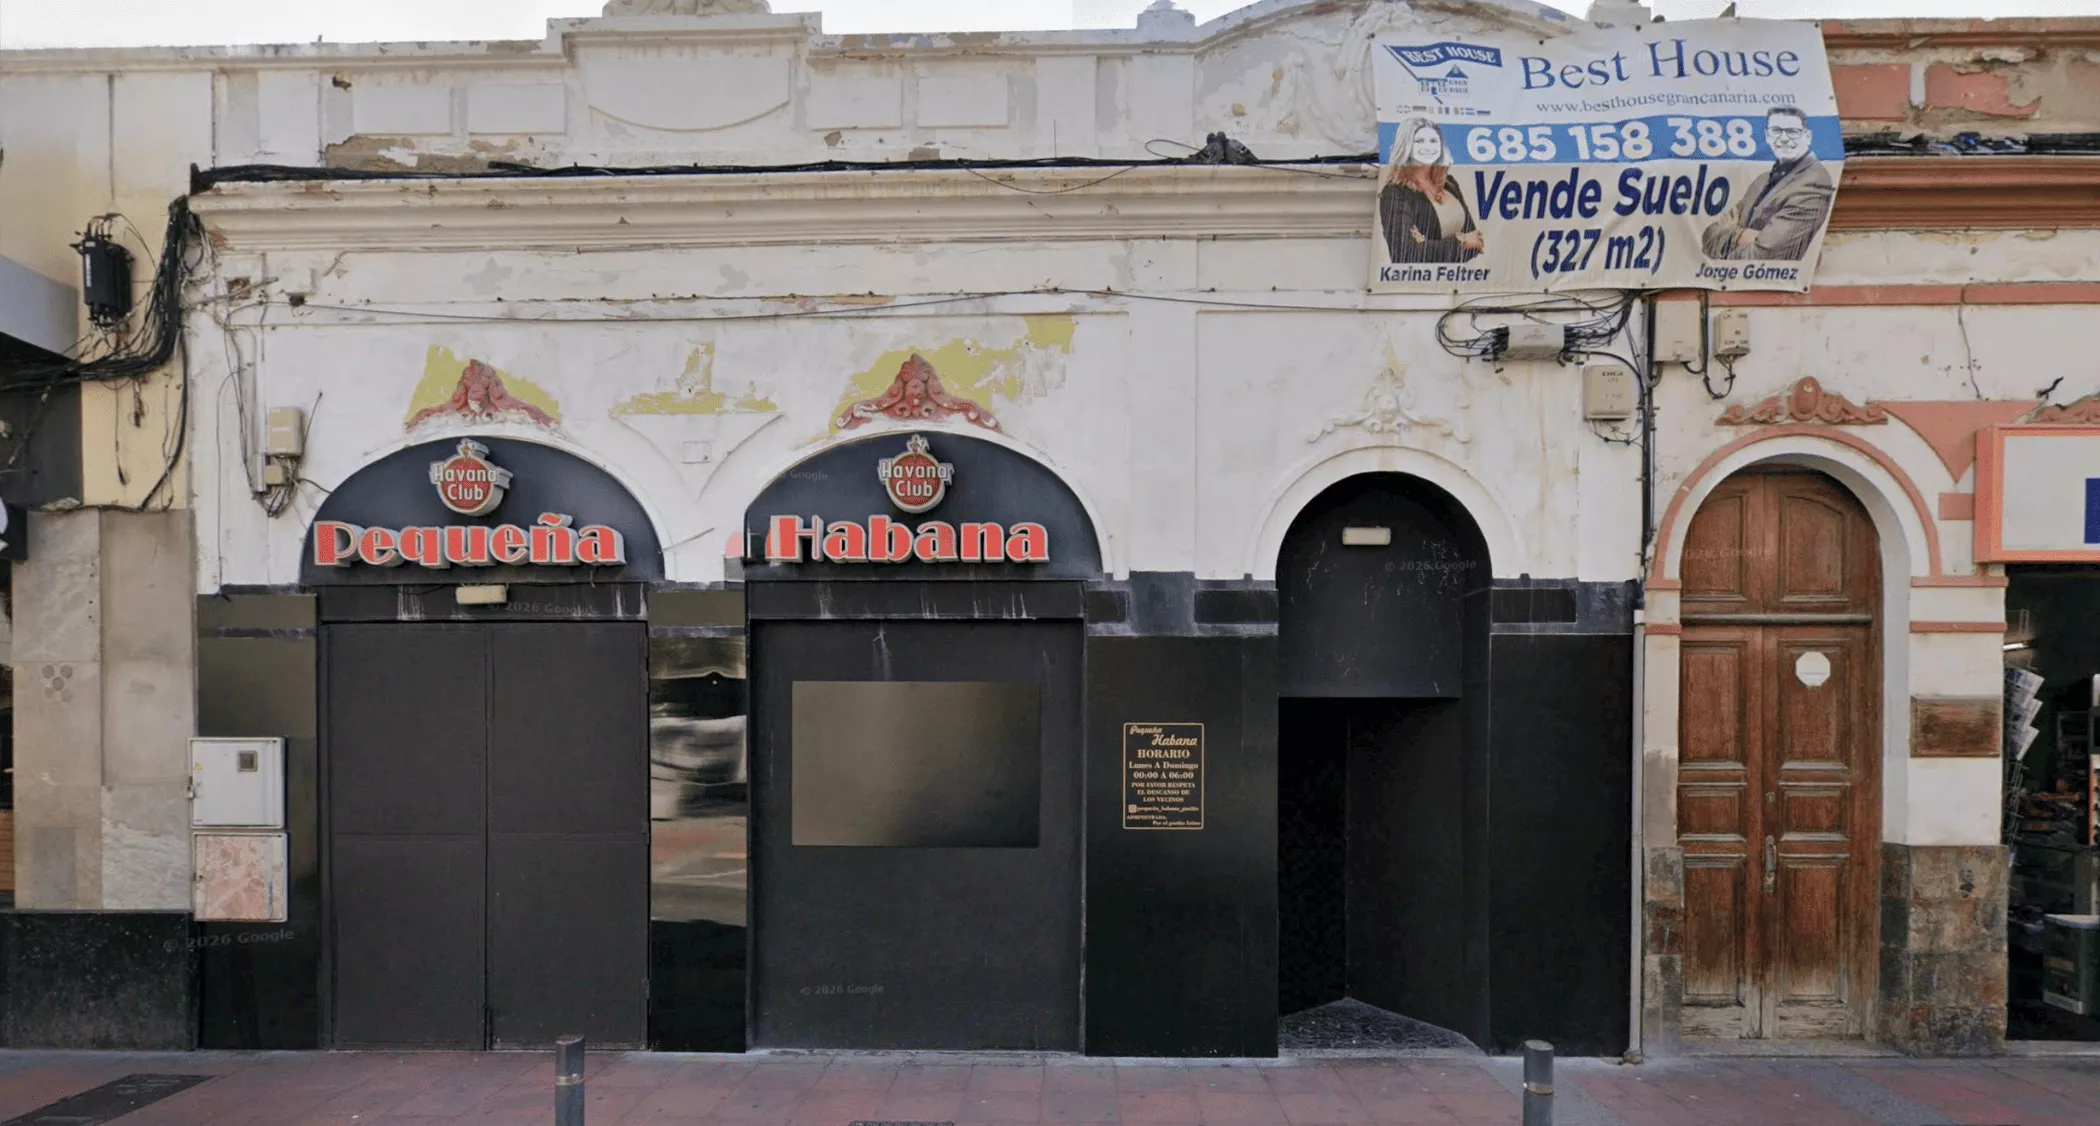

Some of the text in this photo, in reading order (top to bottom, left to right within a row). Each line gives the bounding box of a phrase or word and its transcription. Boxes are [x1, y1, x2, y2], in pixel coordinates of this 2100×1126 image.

[1401, 46, 1497, 63] BEST HOUSE
[1520, 38, 1800, 90] Best House
[1536, 90, 1796, 114] www.besthousegrancanaria.com
[1466, 117, 1757, 162] 685 158 388
[1474, 163, 1730, 220] Vende Suelo
[1531, 225, 1665, 280] (327 m2)
[1380, 265, 1490, 282] Karina Feltrer
[1696, 262, 1798, 282] Jorge Gómez
[434, 466, 499, 484] Havana
[881, 462, 949, 480] Havana
[447, 484, 485, 502] Club
[895, 480, 934, 497] Club
[314, 512, 624, 567] Pequeña
[769, 514, 1050, 562] Habana
[1129, 725, 1163, 735] Pequeña
[1151, 734, 1198, 746] Habana
[1137, 749, 1190, 759] HORARIO
[1128, 761, 1199, 770] Lunes A Domingo
[1133, 771, 1194, 779] 00:00 A 06:00
